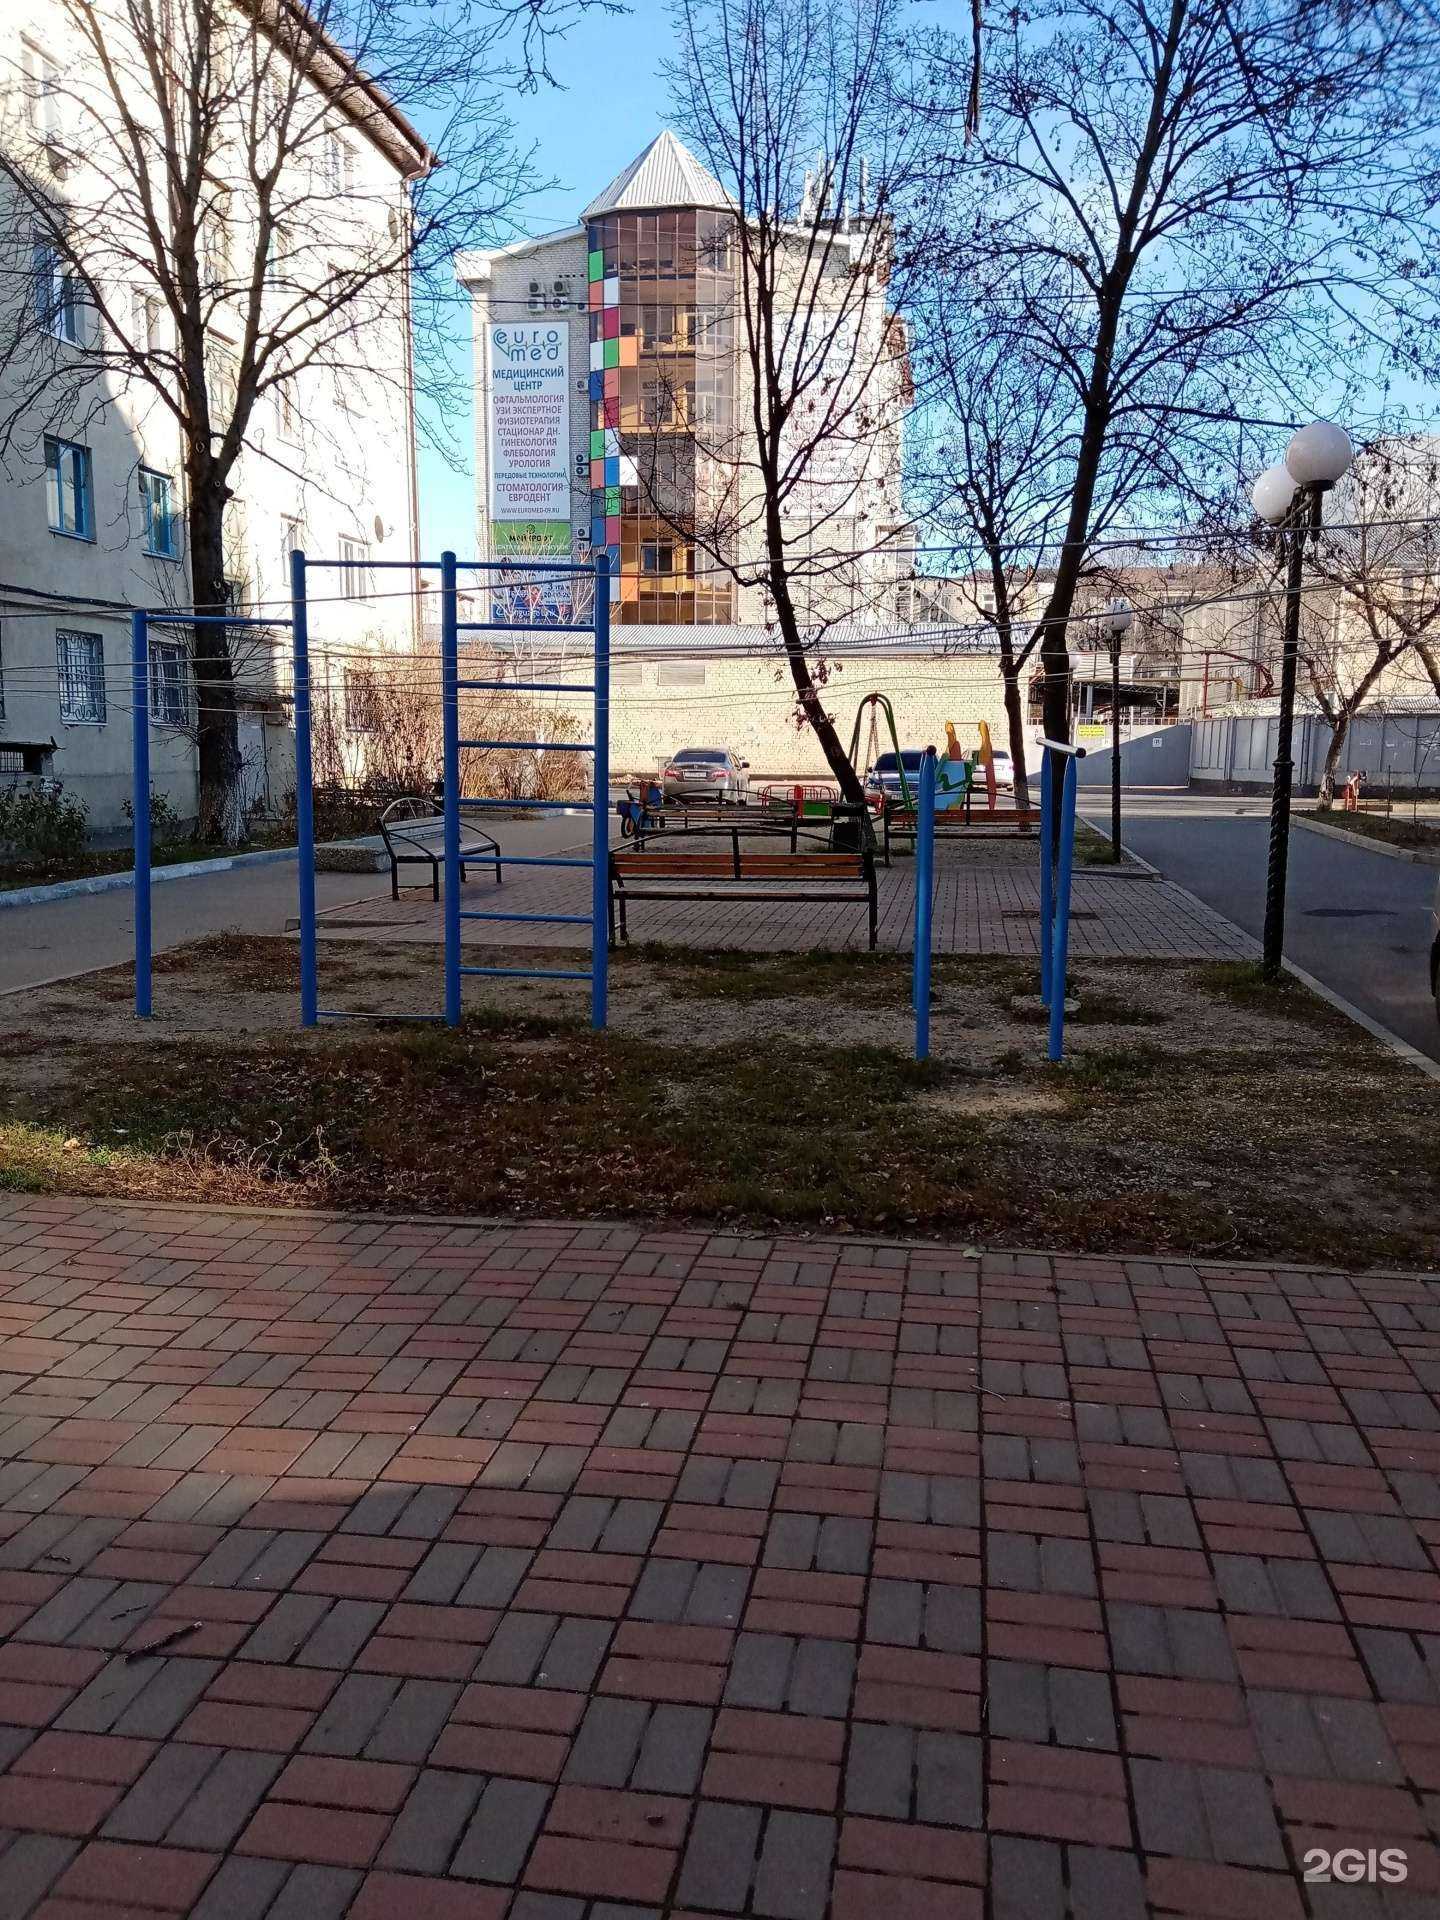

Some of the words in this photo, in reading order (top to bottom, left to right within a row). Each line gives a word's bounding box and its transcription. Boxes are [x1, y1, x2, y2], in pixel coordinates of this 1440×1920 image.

[494, 328, 558, 344] euro
[510, 345, 559, 361] med
[492, 366, 564, 380] МЕДИЦИНСКИЙ
[513, 381, 542, 392] ЦЕНТР
[493, 395, 564, 404] ОФТАЛЬМОЛОГИЯ
[496, 406, 511, 415] УЗИ
[513, 405, 562, 414] ЭКСПЕРТНОЕ
[497, 416, 560, 425] ФИЗИОТЕРАПИЯ
[497, 427, 545, 437] СТАЦИОНАР
[546, 427, 561, 437] ДН.
[501, 438, 557, 447] ГИНЕКОЛОГИЯ
[503, 449, 556, 457] ФЛЕБОЛОГИЯ
[509, 459, 551, 468] УРОЛОГИЯ
[496, 483, 564, 492] СТОМАТОЛОГИЯ
[508, 493, 551, 503] ЕВРОДЕНТ
